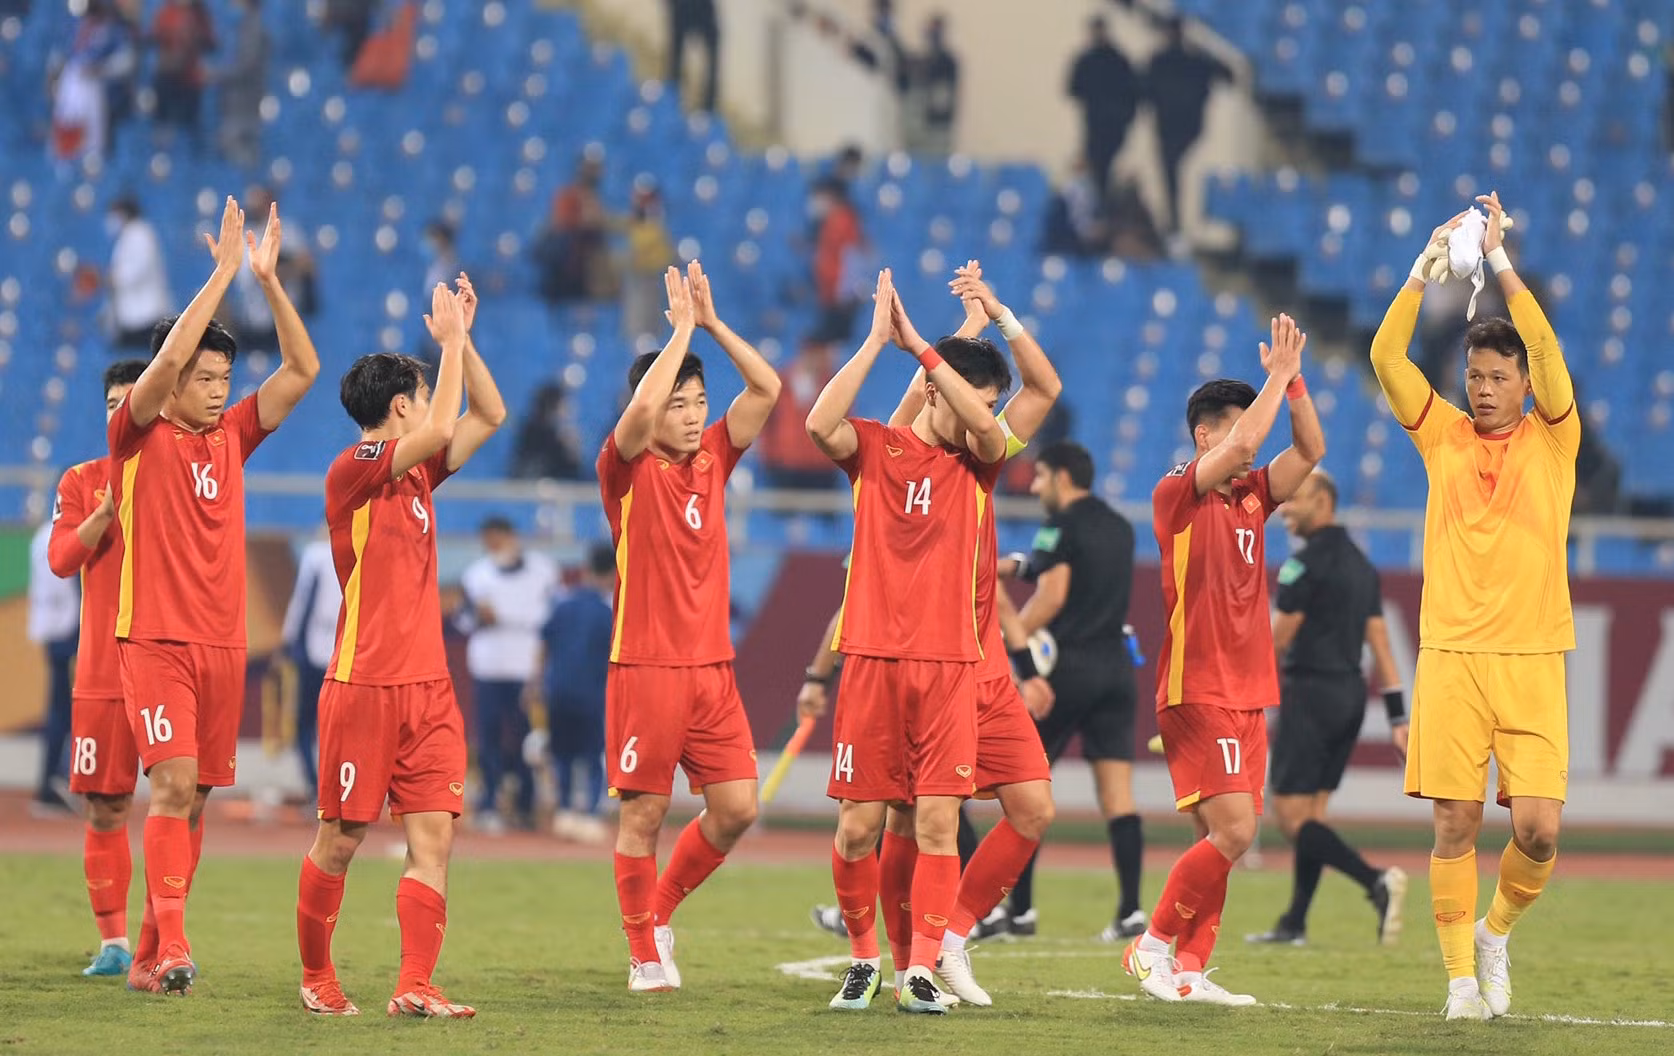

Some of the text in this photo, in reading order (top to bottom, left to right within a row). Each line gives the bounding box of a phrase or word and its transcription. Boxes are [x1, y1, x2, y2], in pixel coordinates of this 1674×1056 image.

[191, 462, 218, 500] 16
[904, 477, 932, 515] 14
[412, 496, 429, 534] 9
[684, 494, 702, 530] 6
[140, 704, 173, 745] 16
[73, 736, 97, 775] 18
[619, 736, 638, 773] 6
[834, 742, 854, 783] 14
[1216, 737, 1241, 775] 17
[340, 761, 356, 802] 9
